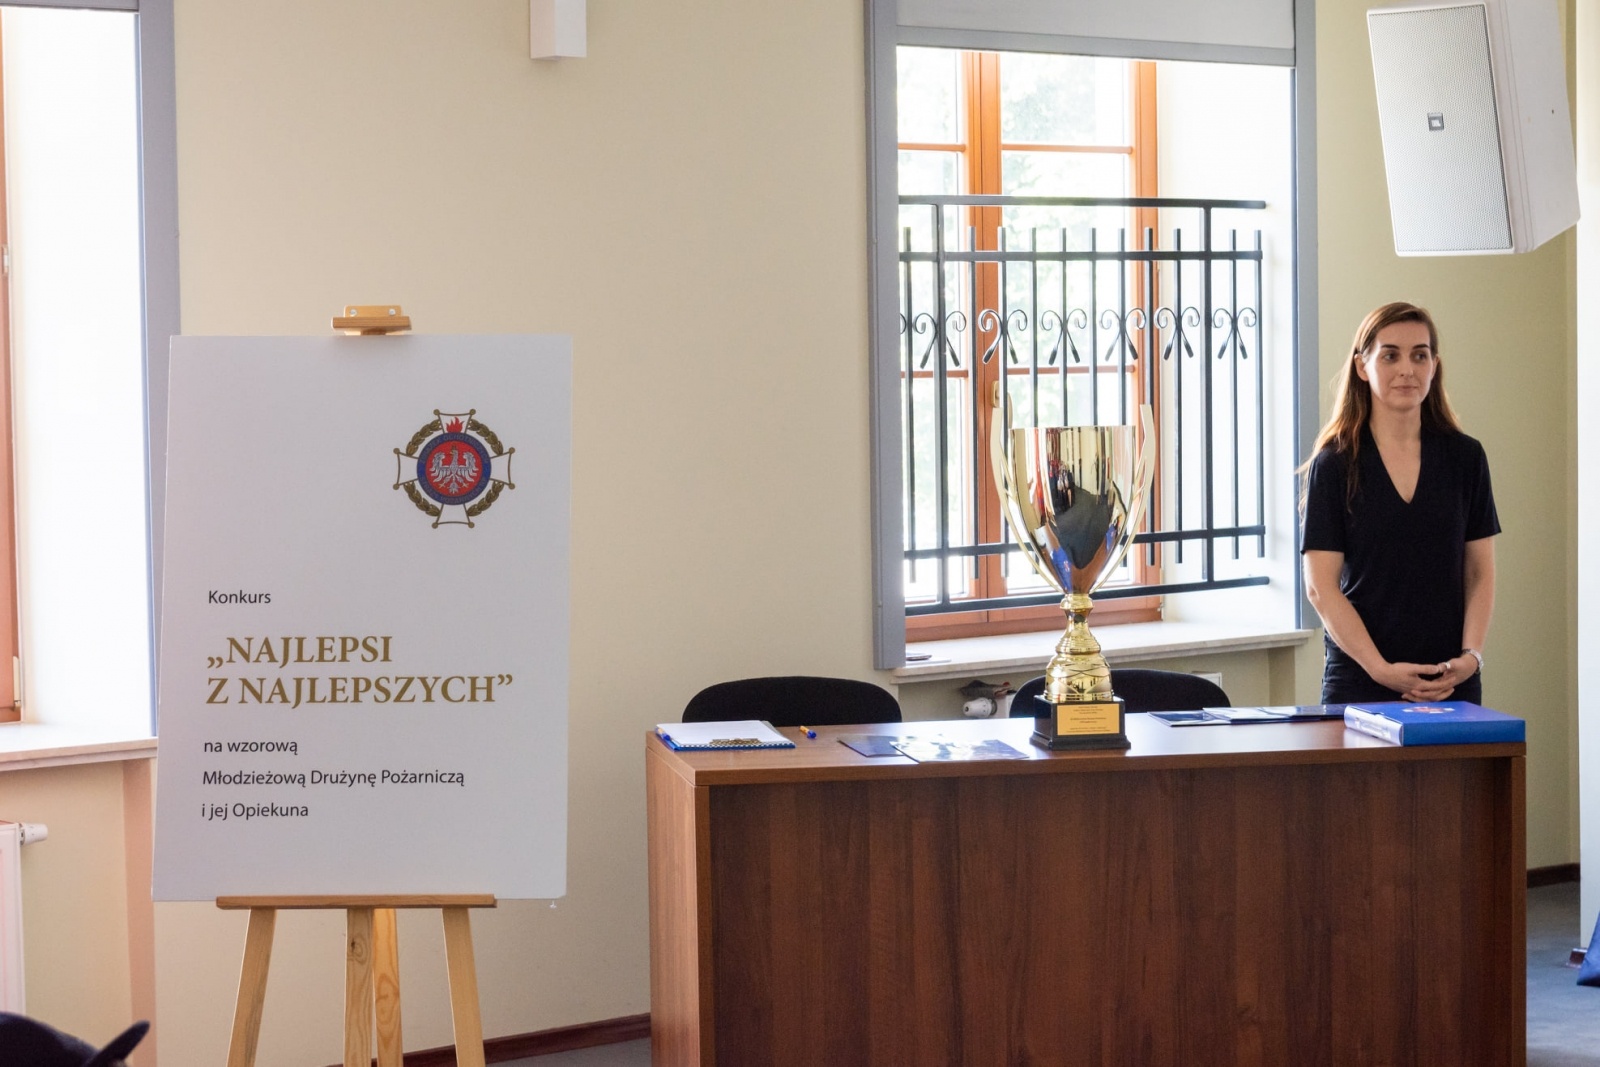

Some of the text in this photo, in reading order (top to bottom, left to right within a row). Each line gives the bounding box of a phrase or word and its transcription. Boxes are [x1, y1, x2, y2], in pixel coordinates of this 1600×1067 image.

[208, 589, 272, 605] Konkurs
[207, 635, 393, 669] „NAJLEPSI
[205, 673, 514, 710] Z NAJLEPSZYCH”
[203, 741, 299, 756] na wzorową
[202, 769, 465, 789] Młodzieżową Drużynę Pożarniczą
[201, 802, 309, 822] i jej Opiekuna
